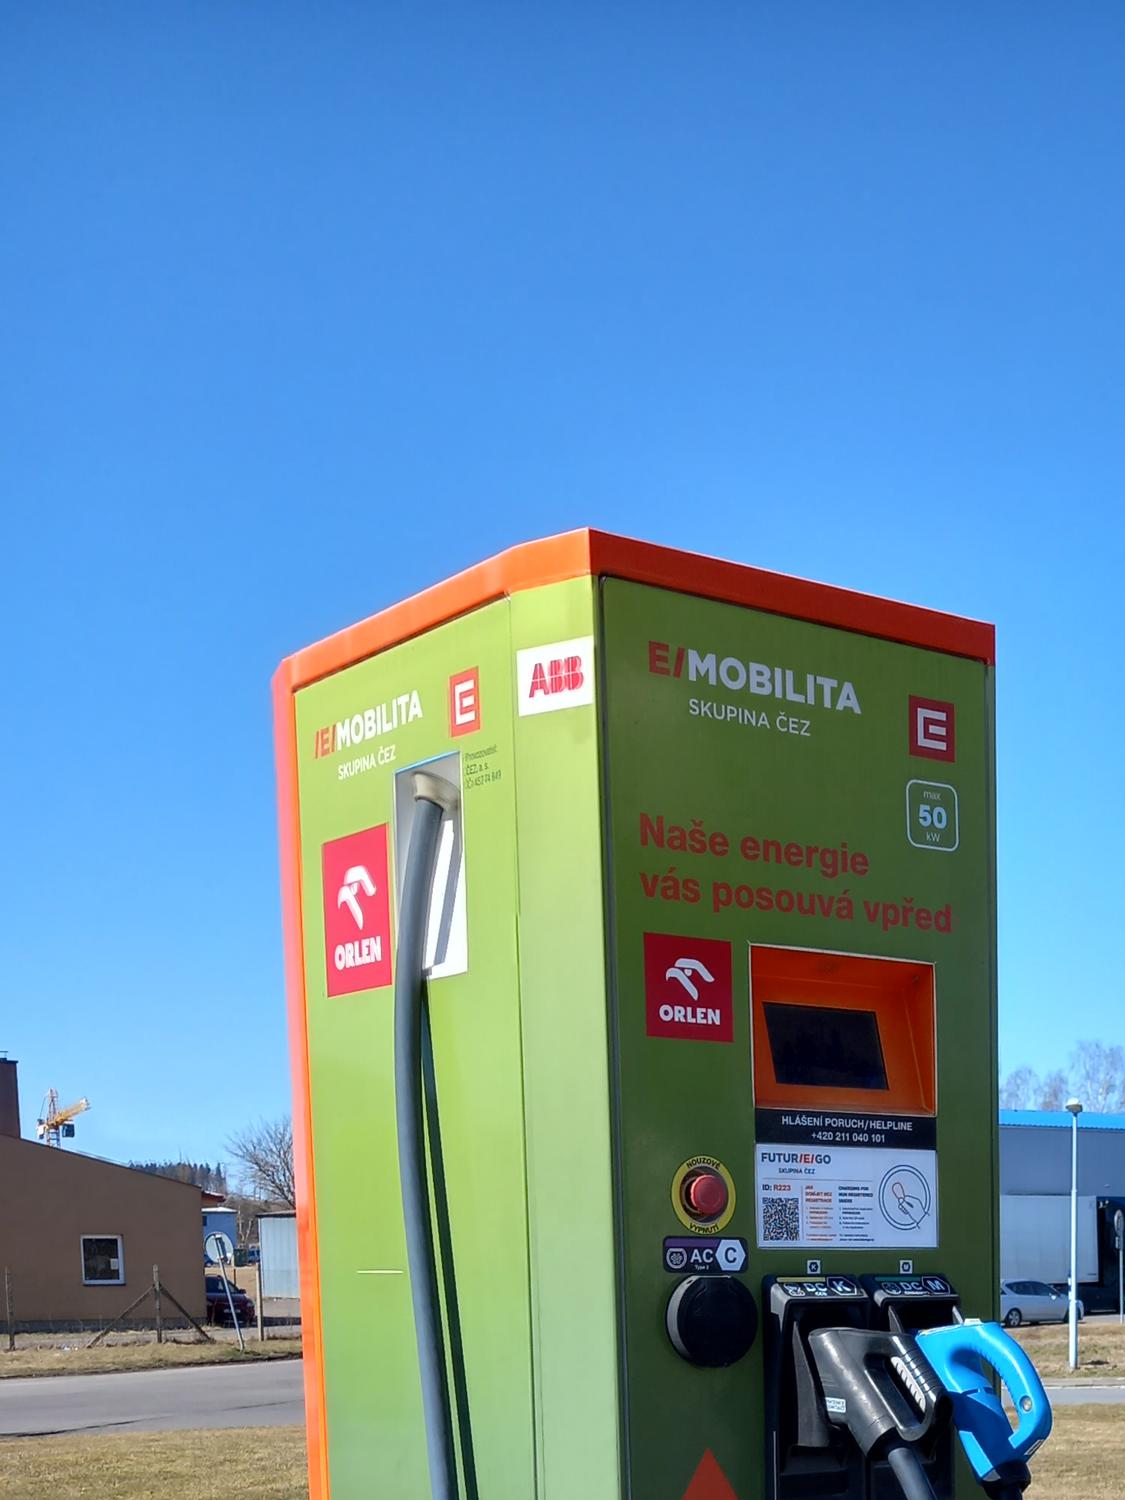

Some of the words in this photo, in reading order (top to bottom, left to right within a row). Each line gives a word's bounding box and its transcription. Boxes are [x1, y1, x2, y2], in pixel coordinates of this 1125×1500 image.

[529, 655, 584, 698] ABB
[689, 698, 770, 729] SKUPINA
[775, 711, 811, 736] ČEZ
[338, 756, 377, 780] SKUPINA
[377, 744, 396, 766] ČEZ
[918, 804, 947, 829] 50
[926, 832, 941, 843] kW
[639, 813, 730, 857] Naše
[740, 835, 870, 879] energie
[639, 868, 701, 904] vás
[713, 880, 854, 920] posouvá
[864, 897, 953, 934] vpřed
[334, 935, 382, 971] ORLEN
[658, 1004, 721, 1027] ORLEN
[781, 1114, 823, 1127] HLÁŠENÍ
[825, 1117, 913, 1131] PORUCH/HELPLINE
[811, 1131, 834, 1141] +420
[835, 1132, 850, 1142] 211
[852, 1133, 869, 1143] 040
[871, 1134, 885, 1143] 101
[686, 1157, 721, 1171] NOUZOVÉ
[761, 1152, 832, 1165] FUTUR/E/GO
[804, 1167, 816, 1175] ČEZ
[762, 1184, 772, 1192] ID:
[690, 1248, 714, 1263] AC
[724, 1247, 737, 1263] C
[803, 1282, 827, 1292] DC
[832, 1280, 852, 1292] K
[900, 1282, 923, 1291] DC
[926, 1279, 945, 1291] M
